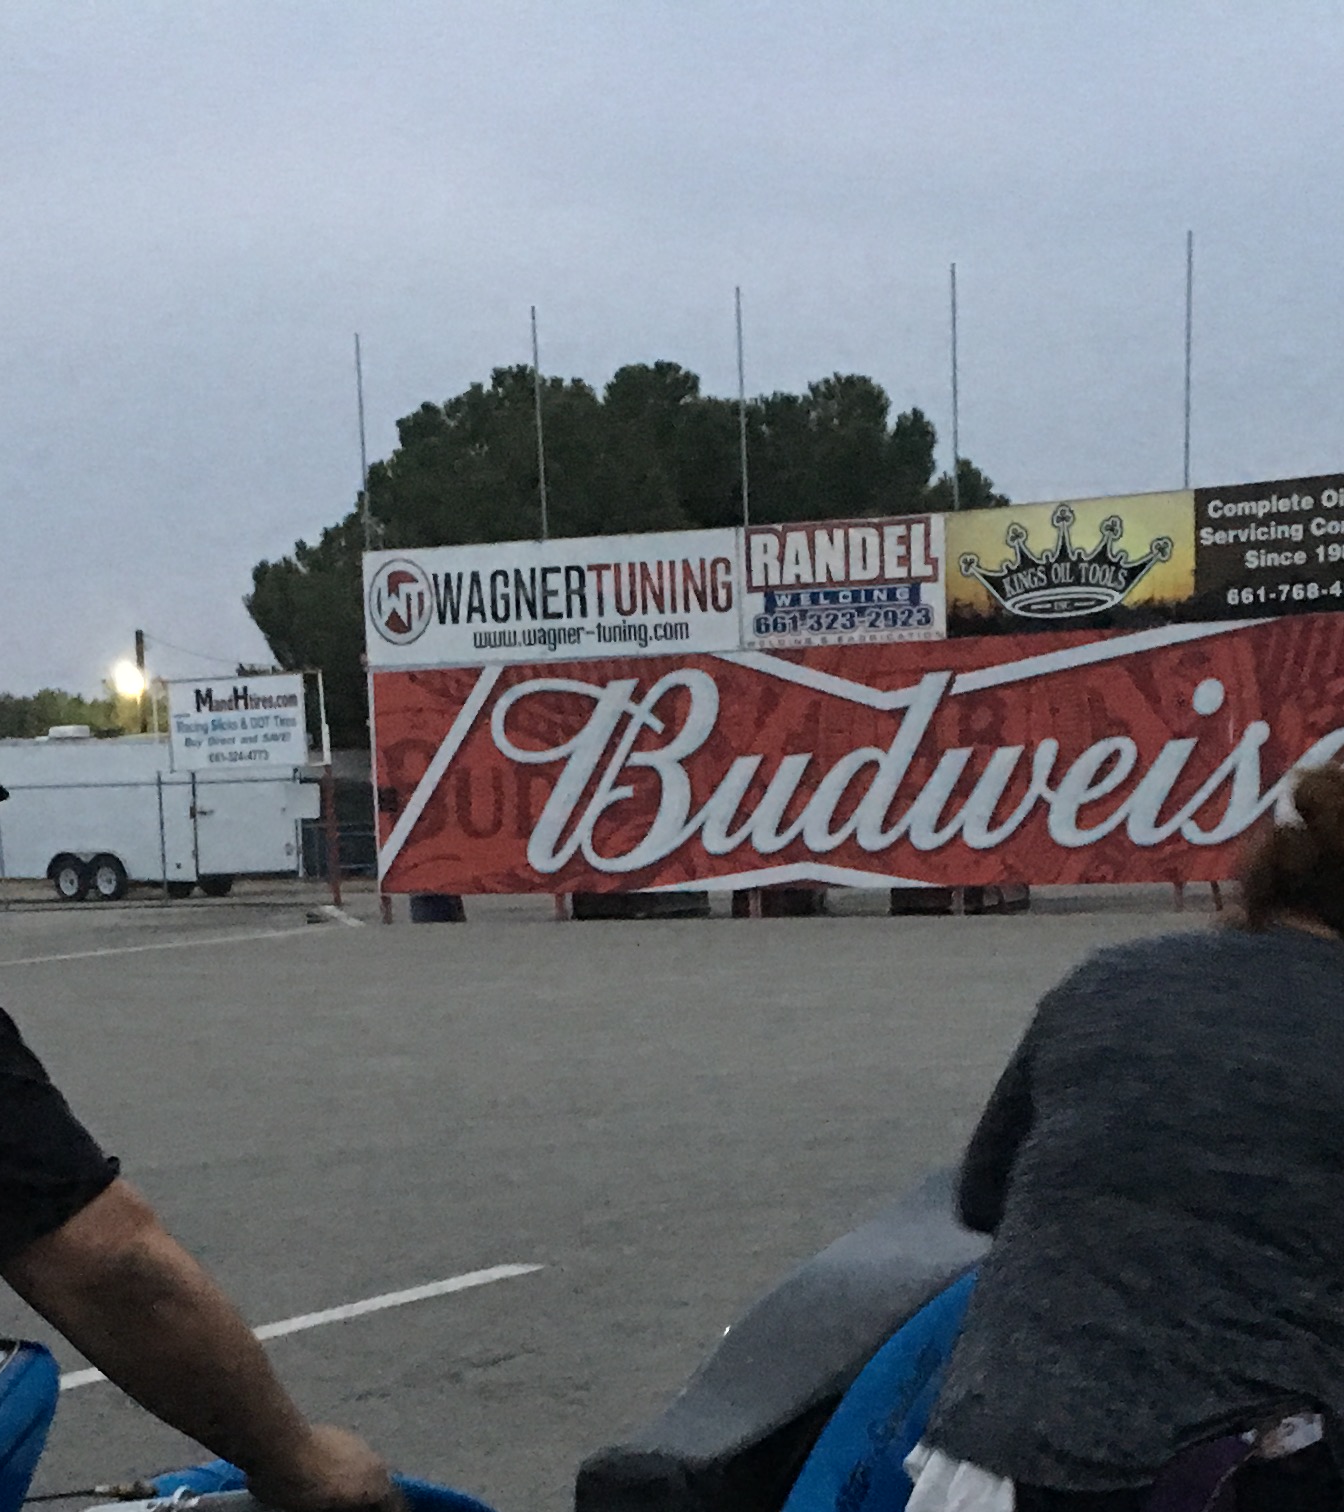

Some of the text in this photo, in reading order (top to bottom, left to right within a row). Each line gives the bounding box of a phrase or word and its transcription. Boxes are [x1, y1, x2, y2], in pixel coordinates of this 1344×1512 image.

[1207, 494, 1315, 518] Complete
[1200, 521, 1304, 545] Servicing
[749, 521, 935, 588] RANDEL
[1244, 549, 1307, 569] Since
[431, 556, 734, 625] WAGNERTUNING
[1002, 562, 1128, 597] KINGS OIL TOOLS
[774, 588, 910, 608] WELDING
[755, 606, 933, 635] 661-323-2923
[473, 620, 690, 651] www.wagner-tuning.com
